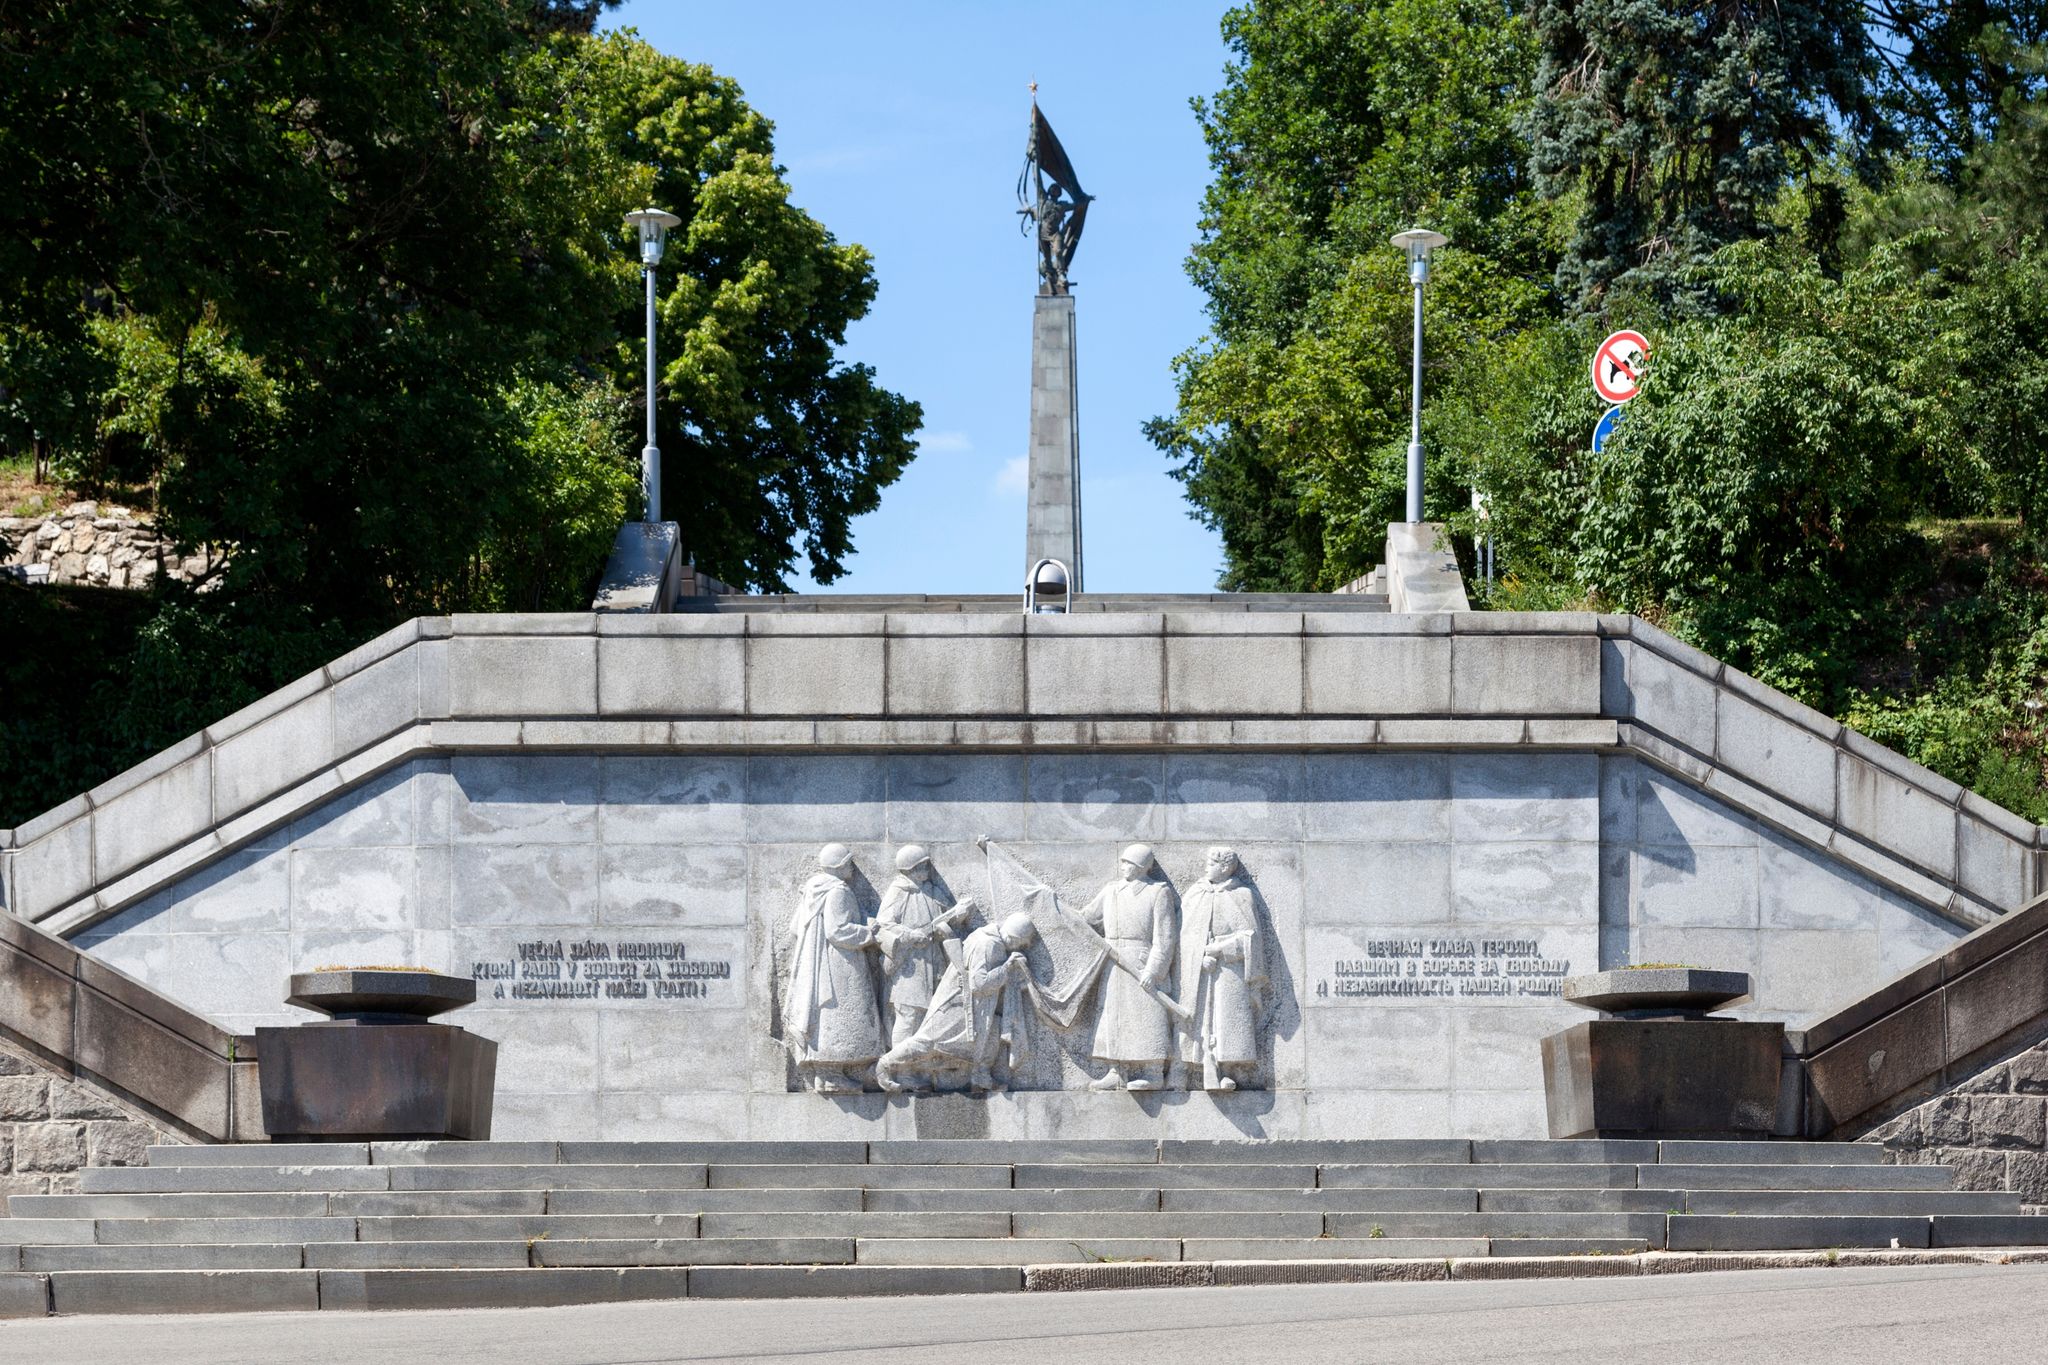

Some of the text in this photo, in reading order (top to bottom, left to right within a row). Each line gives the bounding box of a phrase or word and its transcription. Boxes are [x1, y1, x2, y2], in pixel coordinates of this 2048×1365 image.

[570, 940, 611, 960] SLÁVA
[1367, 939, 1542, 958] ВЕЧНАЯ СЛАВА ГЕРОЯМ,
[471, 959, 515, 979] KTORÍ
[521, 961, 561, 979] PADLI
[566, 961, 577, 979] V
[642, 961, 661, 979] ZA
[666, 961, 730, 979] SLOBODU
[1335, 959, 1570, 977] ПАВШИМ В БОРЬБЕ ЗА СВОБОДУ
[494, 981, 505, 999] A
[1316, 976, 1563, 997] И НЕЗАВИСИМОСТЬ НАШЕЙ РОДИН
